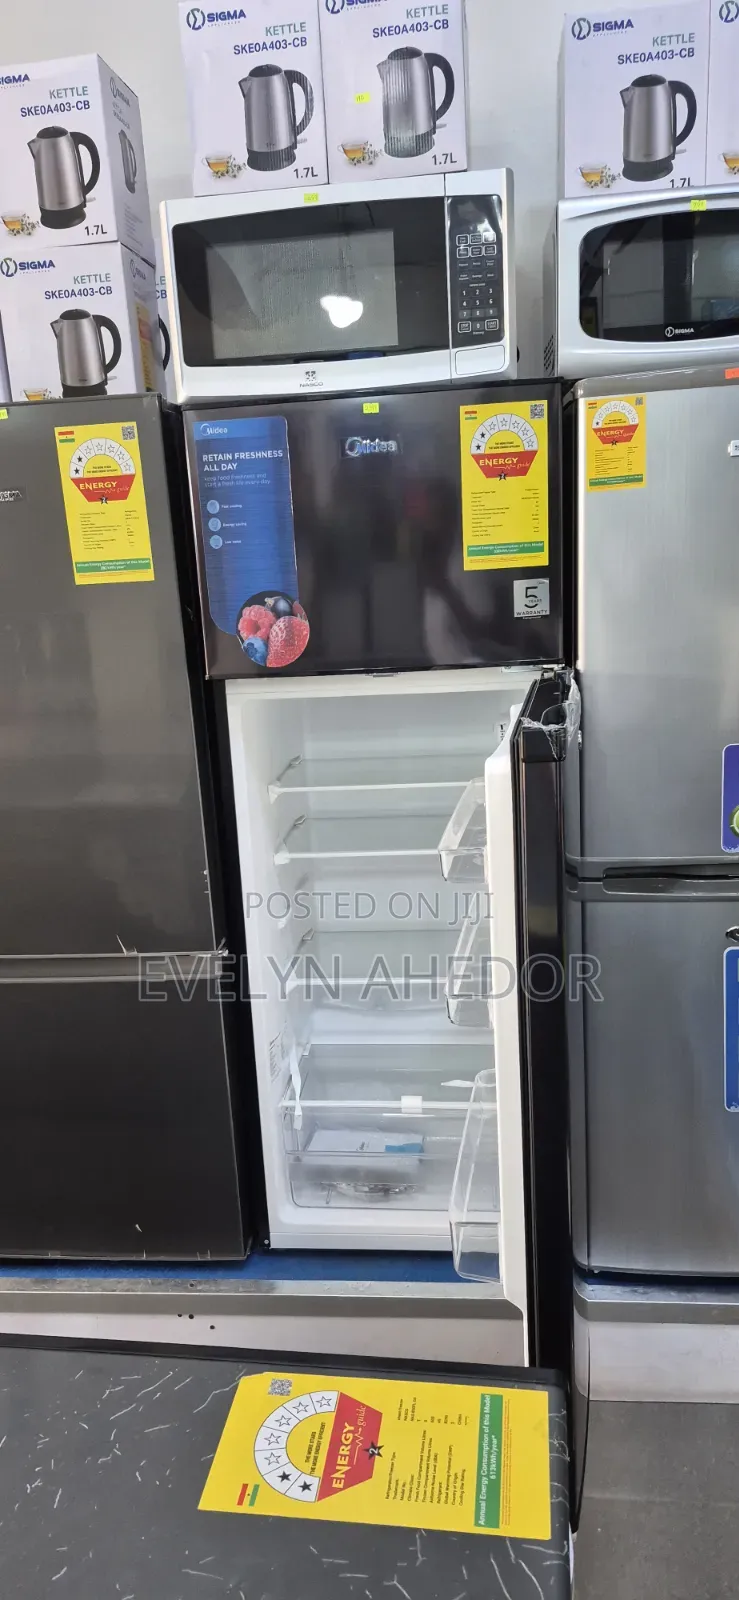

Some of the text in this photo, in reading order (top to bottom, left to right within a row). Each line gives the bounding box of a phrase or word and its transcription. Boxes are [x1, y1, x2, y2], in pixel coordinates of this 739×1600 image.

[206, 9, 246, 22] SIGMA
[406, 4, 449, 19] KETTLE
[265, 22, 307, 36] KETTLE
[593, 19, 634, 32] SIGMA
[652, 32, 695, 47] KETTLE
[49, 86, 88, 99] KETTLE
[432, 153, 457, 166] 1.7L
[294, 166, 318, 179] 1.7L
[84, 224, 108, 236] 1.7L
[18, 260, 56, 270] SIGMA
[73, 273, 111, 285] KETTLE
[347, 437, 398, 456] Midea
[202, 450, 283, 462] RETAIN FRESHNESS
[480, 458, 518, 467] ENERGY
[221, 462, 238, 470] DAY
[80, 482, 117, 490] ENERGY
[524, 586, 538, 608] 5
[356, 1406, 366, 1426] guide
[330, 1422, 354, 1488] ENERGY
[481, 1434, 489, 1475] Consumption
[480, 1477, 488, 1499] Energy
